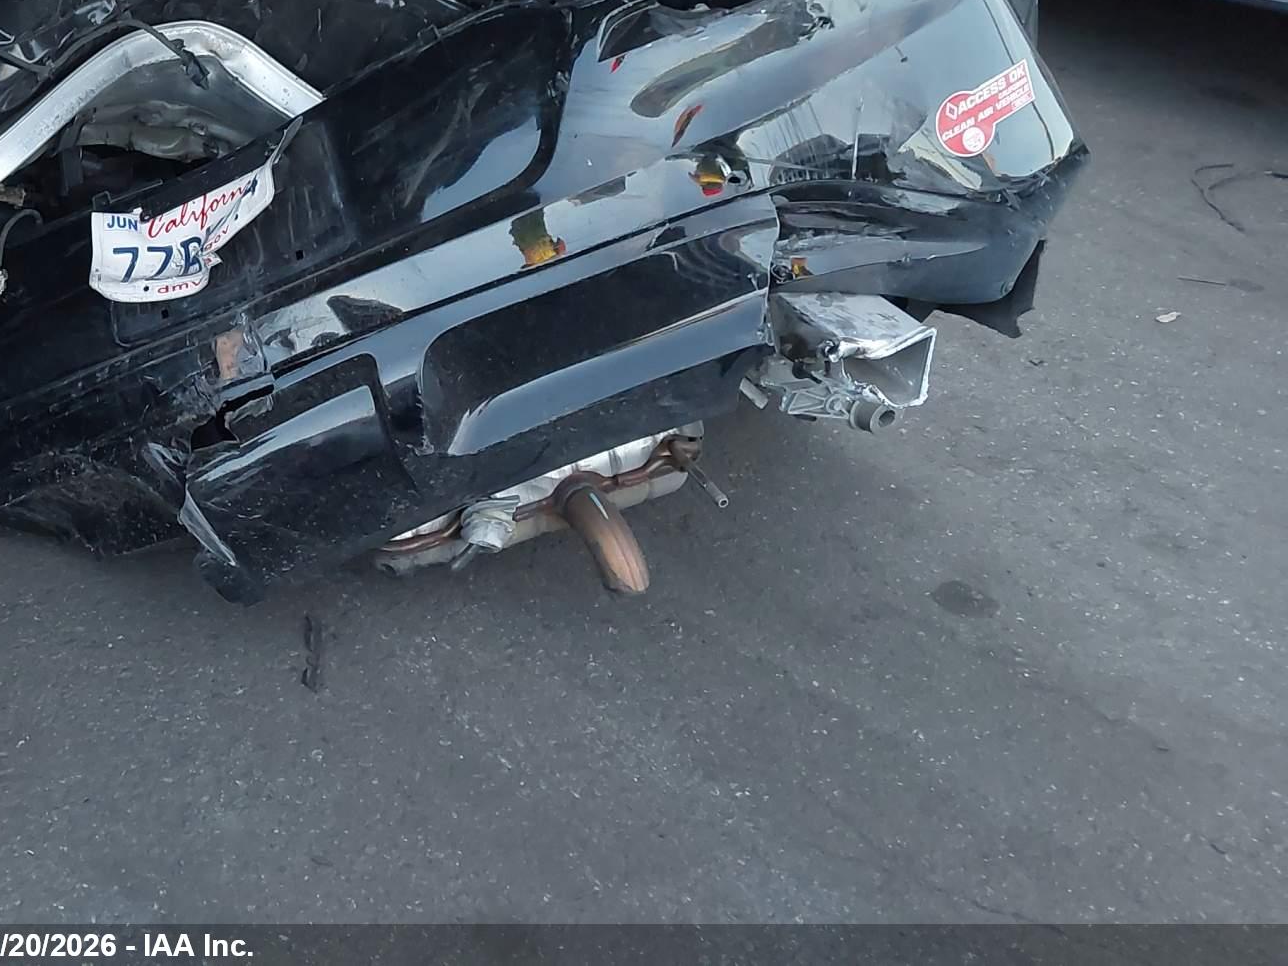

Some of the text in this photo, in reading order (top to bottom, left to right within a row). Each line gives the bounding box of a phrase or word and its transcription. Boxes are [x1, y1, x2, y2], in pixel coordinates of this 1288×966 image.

[959, 77, 1006, 114] ACCESS
[1009, 65, 1026, 82] OK
[942, 117, 976, 141] CLEAN
[978, 106, 994, 122] AIR
[107, 216, 138, 231] JUN
[147, 178, 258, 238] Californi
[158, 280, 201, 294] dmv
